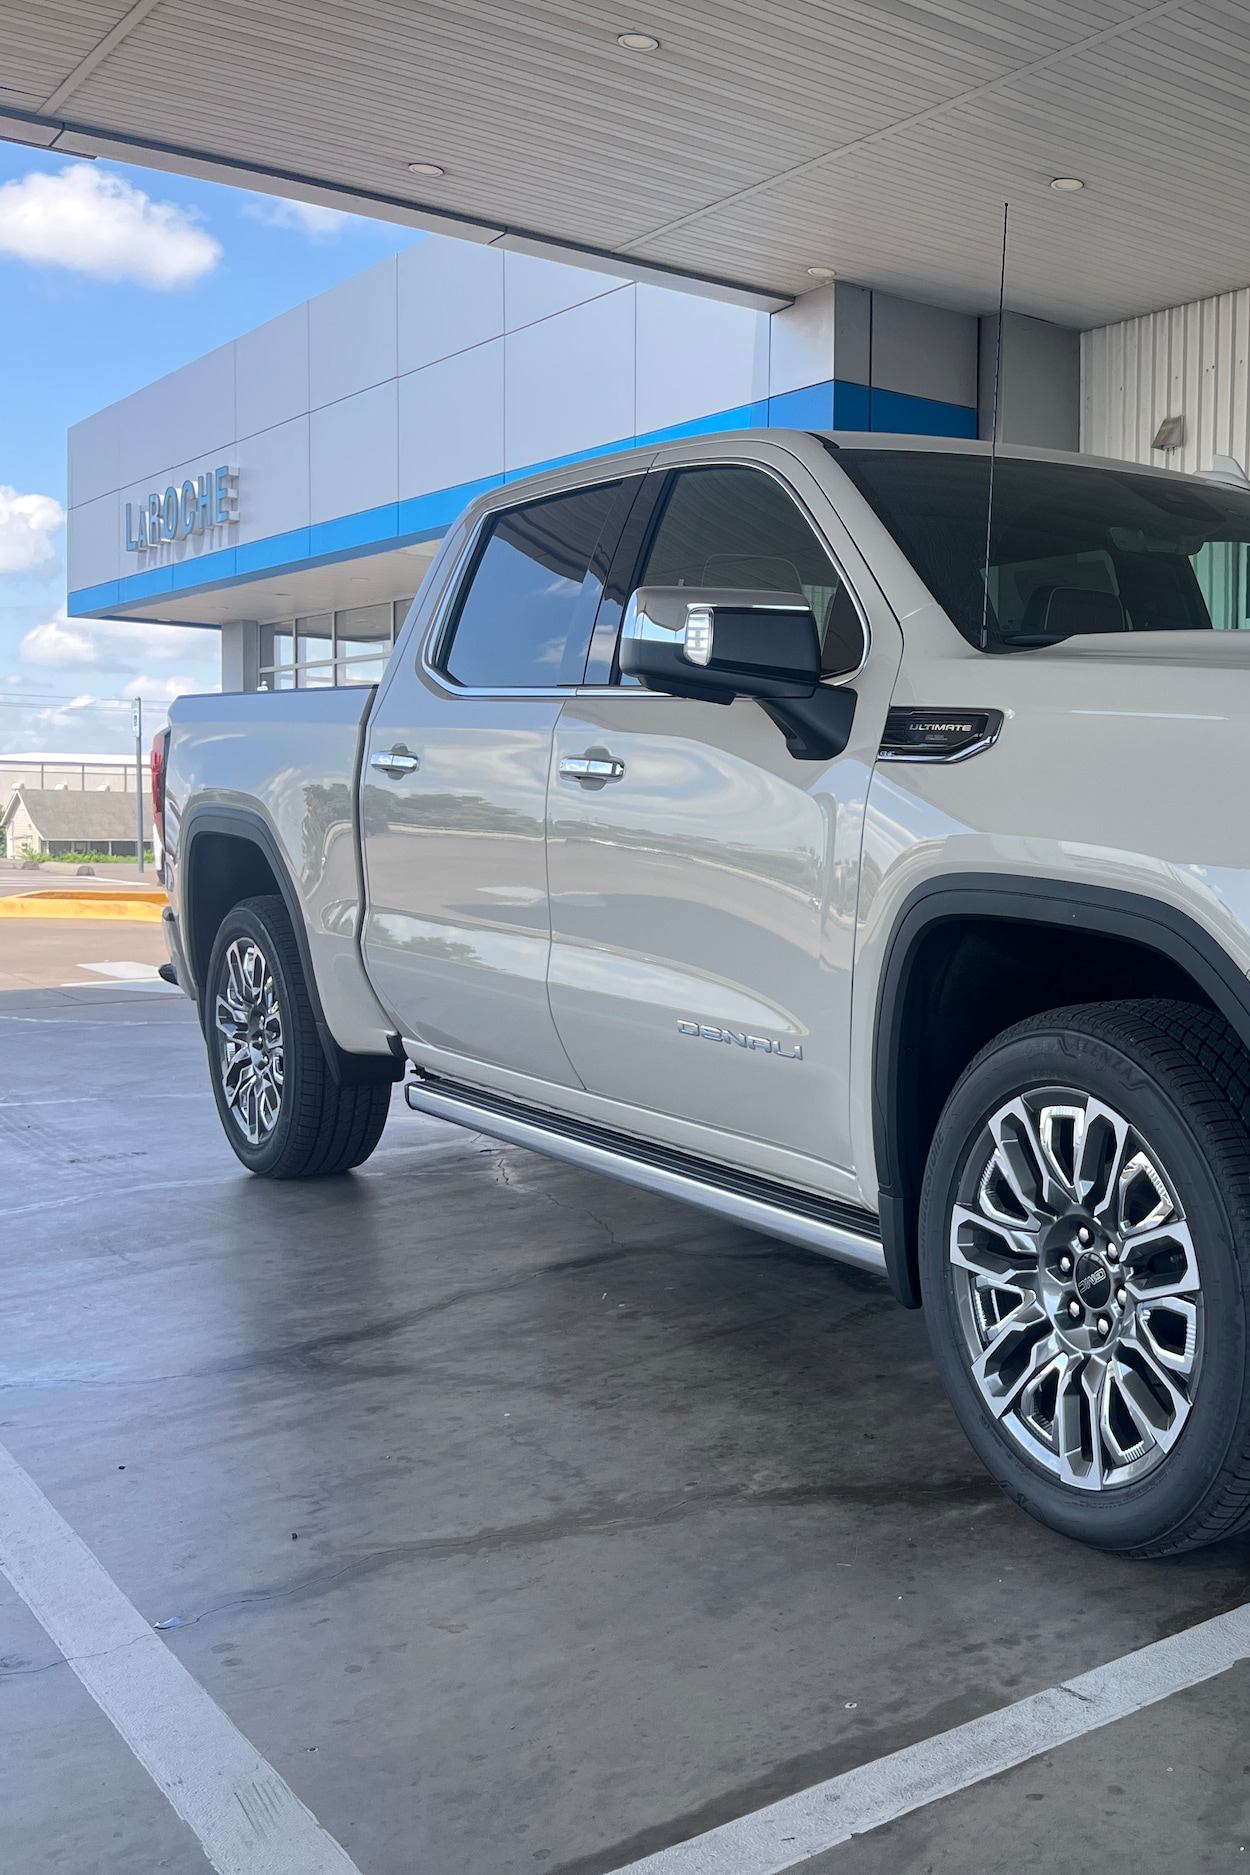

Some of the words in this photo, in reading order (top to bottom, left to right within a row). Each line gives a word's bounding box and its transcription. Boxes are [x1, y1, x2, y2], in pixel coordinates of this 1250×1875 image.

[126, 465, 234, 552] LAROCHE
[909, 723, 972, 732] ULTIMATE
[677, 1019, 803, 1061] DENALI
[1078, 1268, 1106, 1294] GMC
